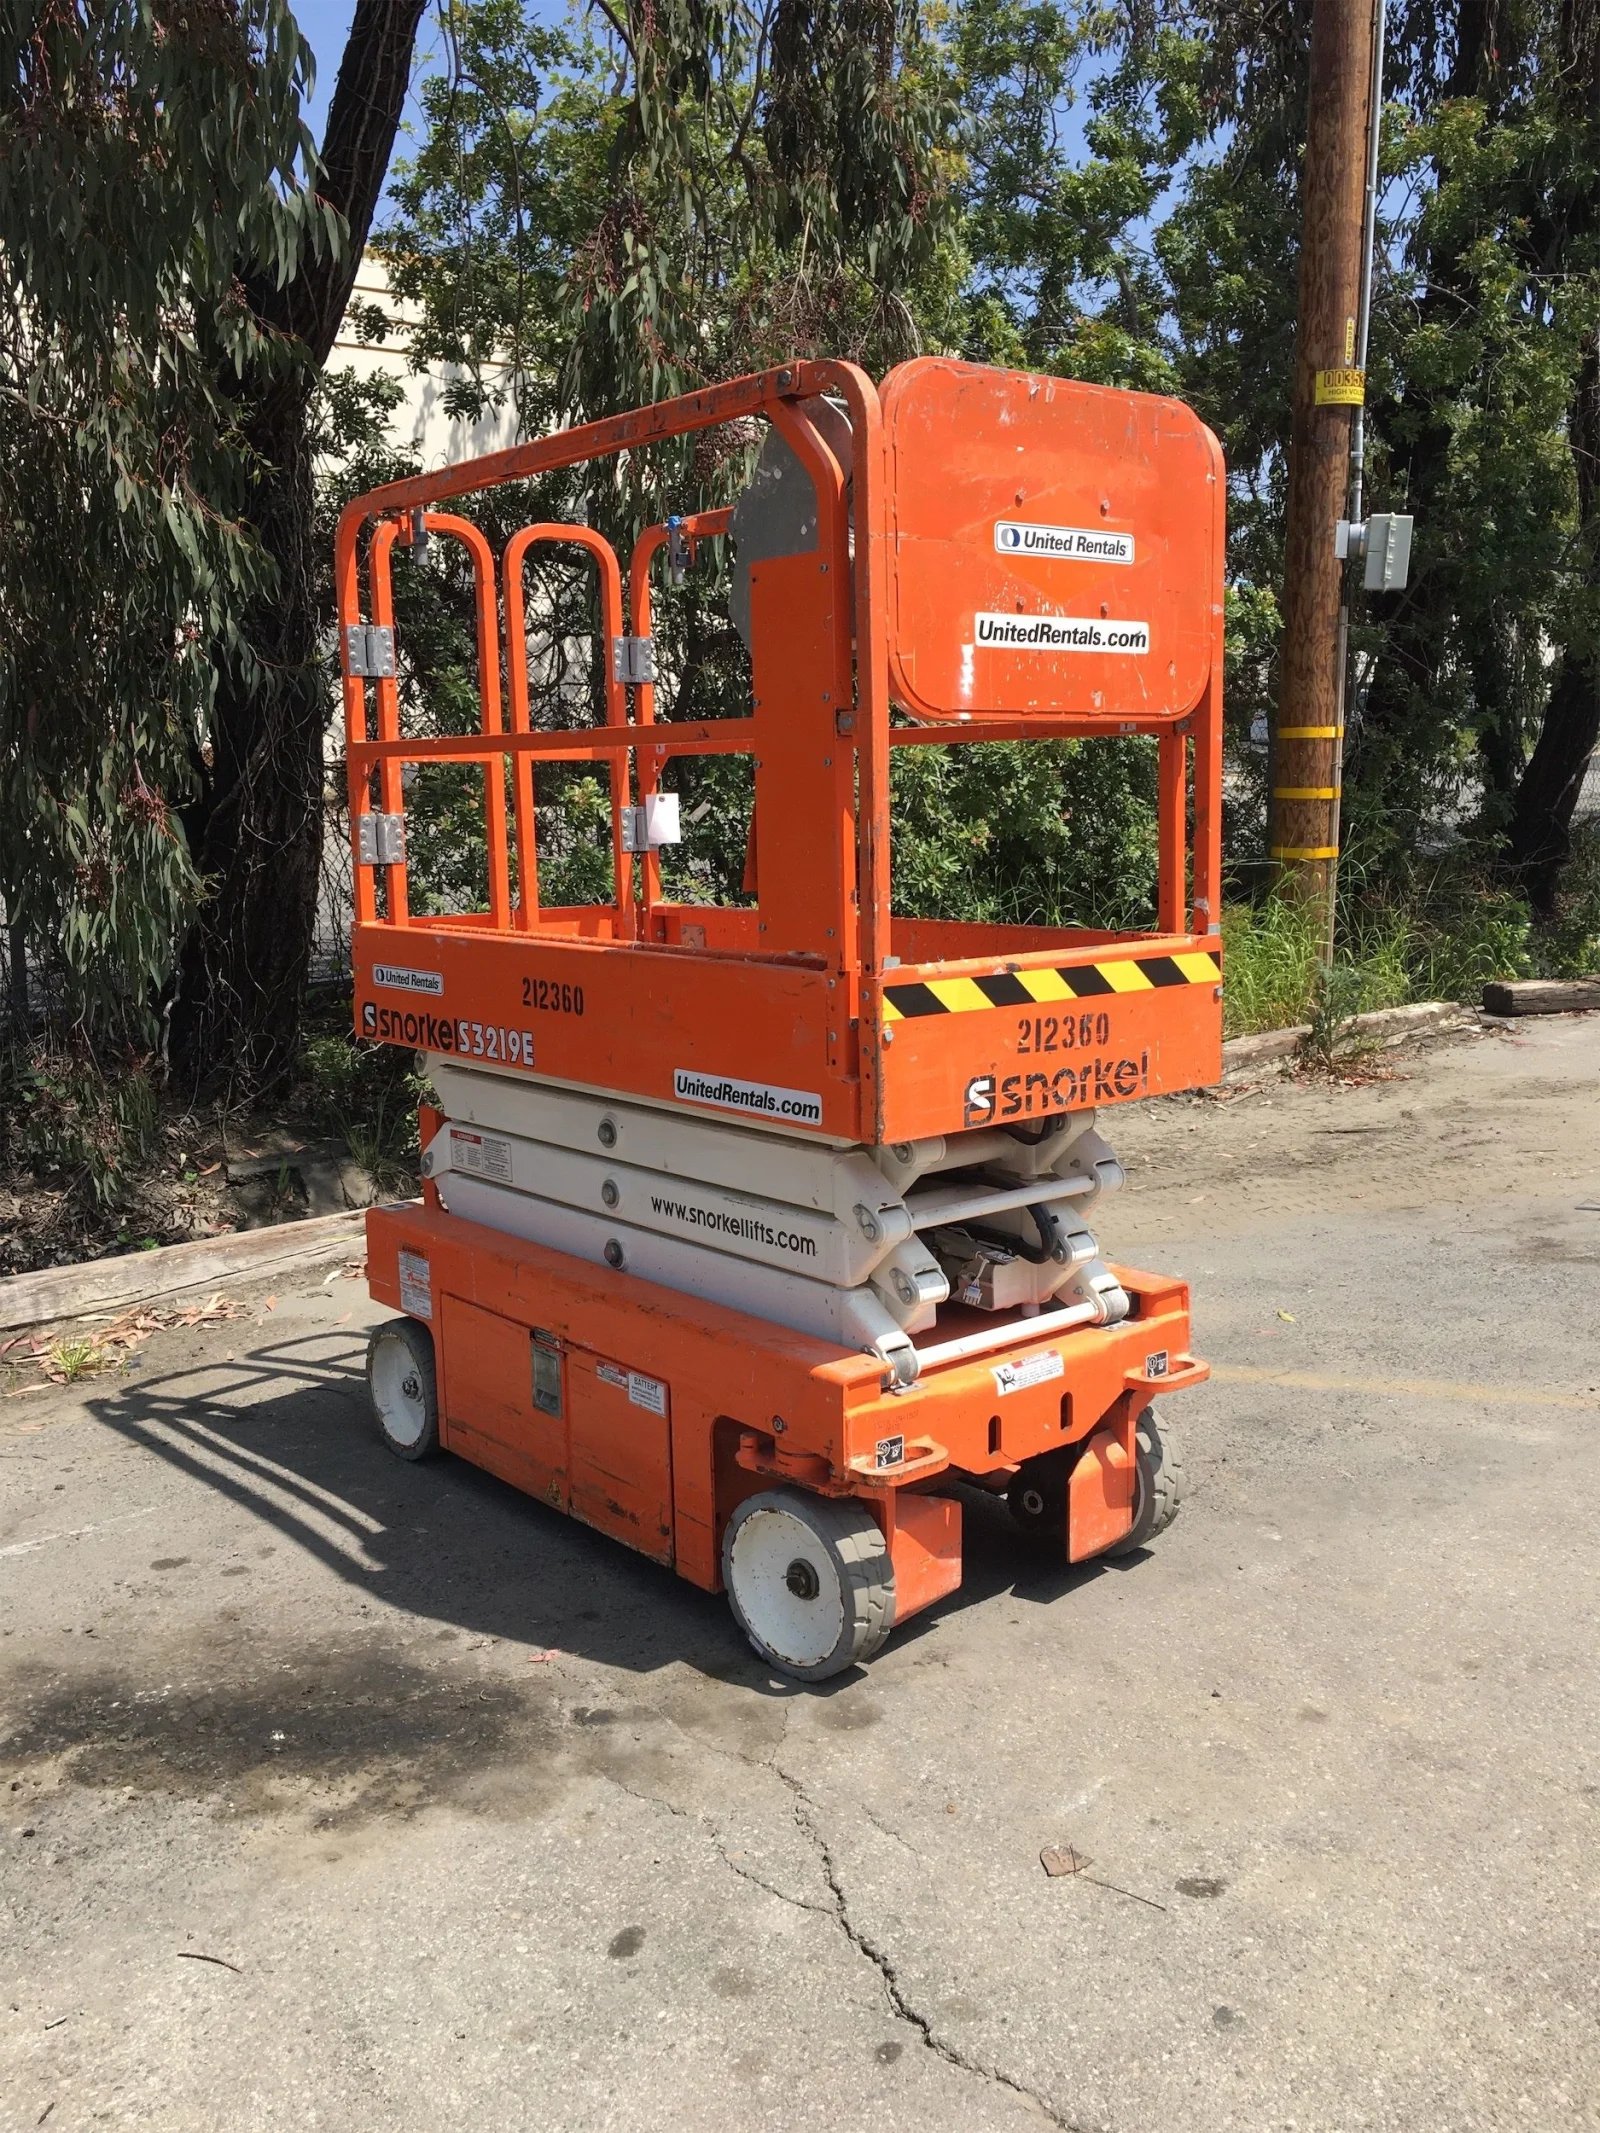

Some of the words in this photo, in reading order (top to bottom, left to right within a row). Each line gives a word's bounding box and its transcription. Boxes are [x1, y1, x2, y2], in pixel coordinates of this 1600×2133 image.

[1024, 531, 1073, 551] United
[1076, 536, 1127, 557] Rentals
[978, 620, 1147, 648] UnitedRentals.com
[385, 969, 410, 986] United
[411, 974, 440, 990] Rentals
[522, 976, 585, 1016] 212360
[458, 1020, 535, 1067] S3219E
[1017, 1012, 1110, 1054] 212360
[676, 1075, 820, 1119] UnitedRentals.com
[1001, 1051, 1149, 1116] snorkel
[651, 1196, 816, 1256] www.snorkellifts.com
[633, 1376, 658, 1394] BATTERY
